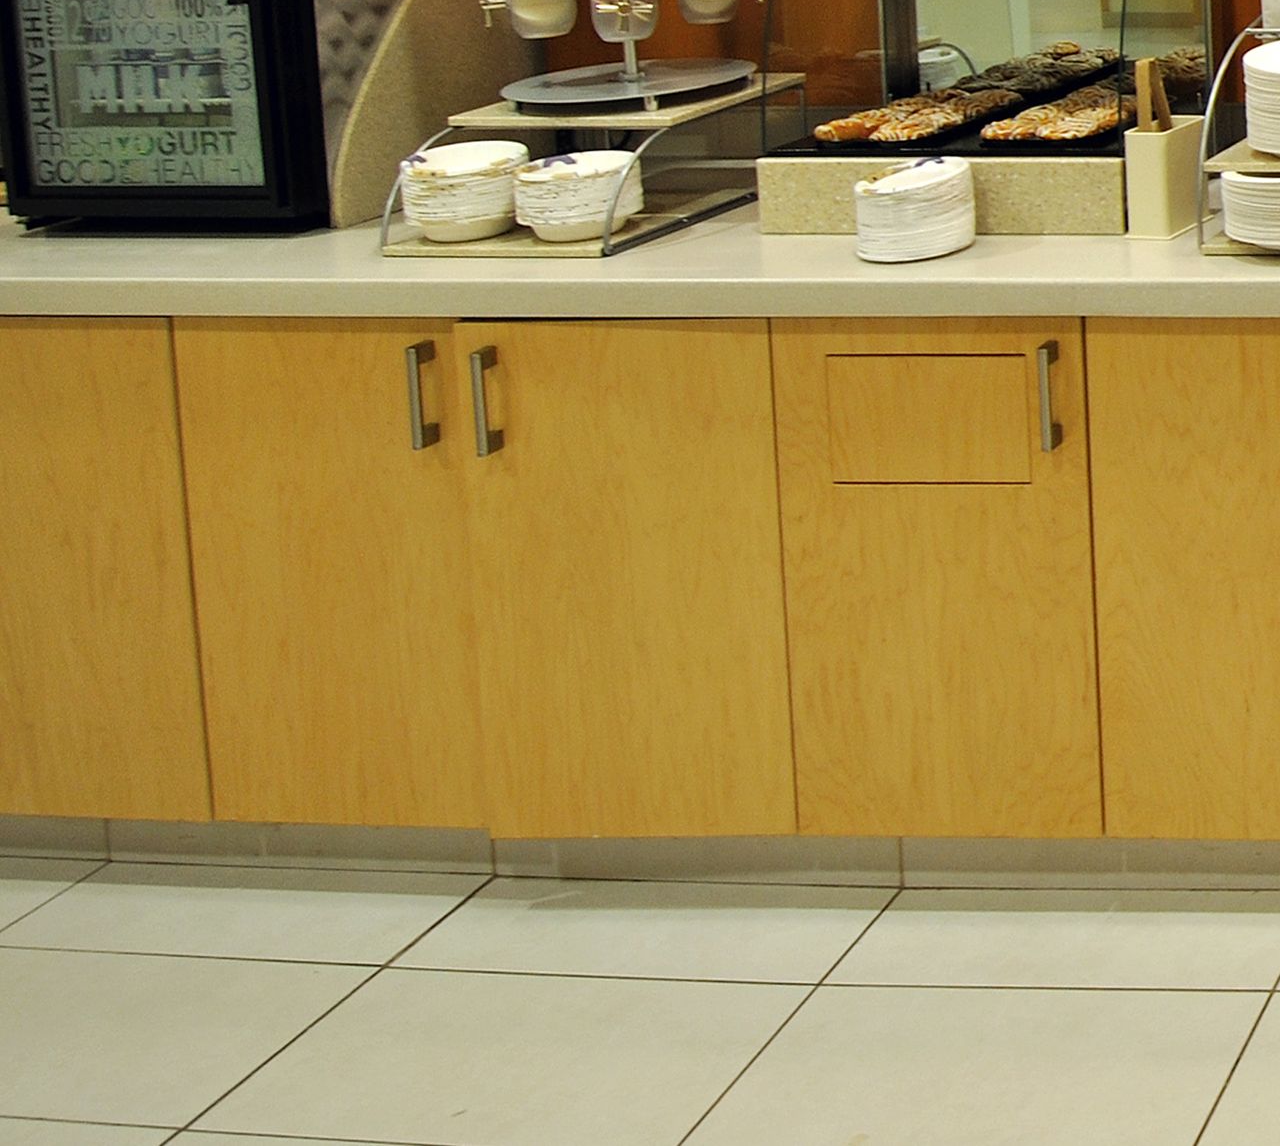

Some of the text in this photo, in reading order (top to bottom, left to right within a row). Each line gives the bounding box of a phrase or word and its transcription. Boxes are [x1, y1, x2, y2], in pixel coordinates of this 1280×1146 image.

[117, 20, 221, 45] YOGURT
[23, 15, 53, 129] HEALTHY
[77, 64, 206, 114] MILK
[116, 130, 238, 155] YOGURT
[37, 159, 116, 184] GOOD
